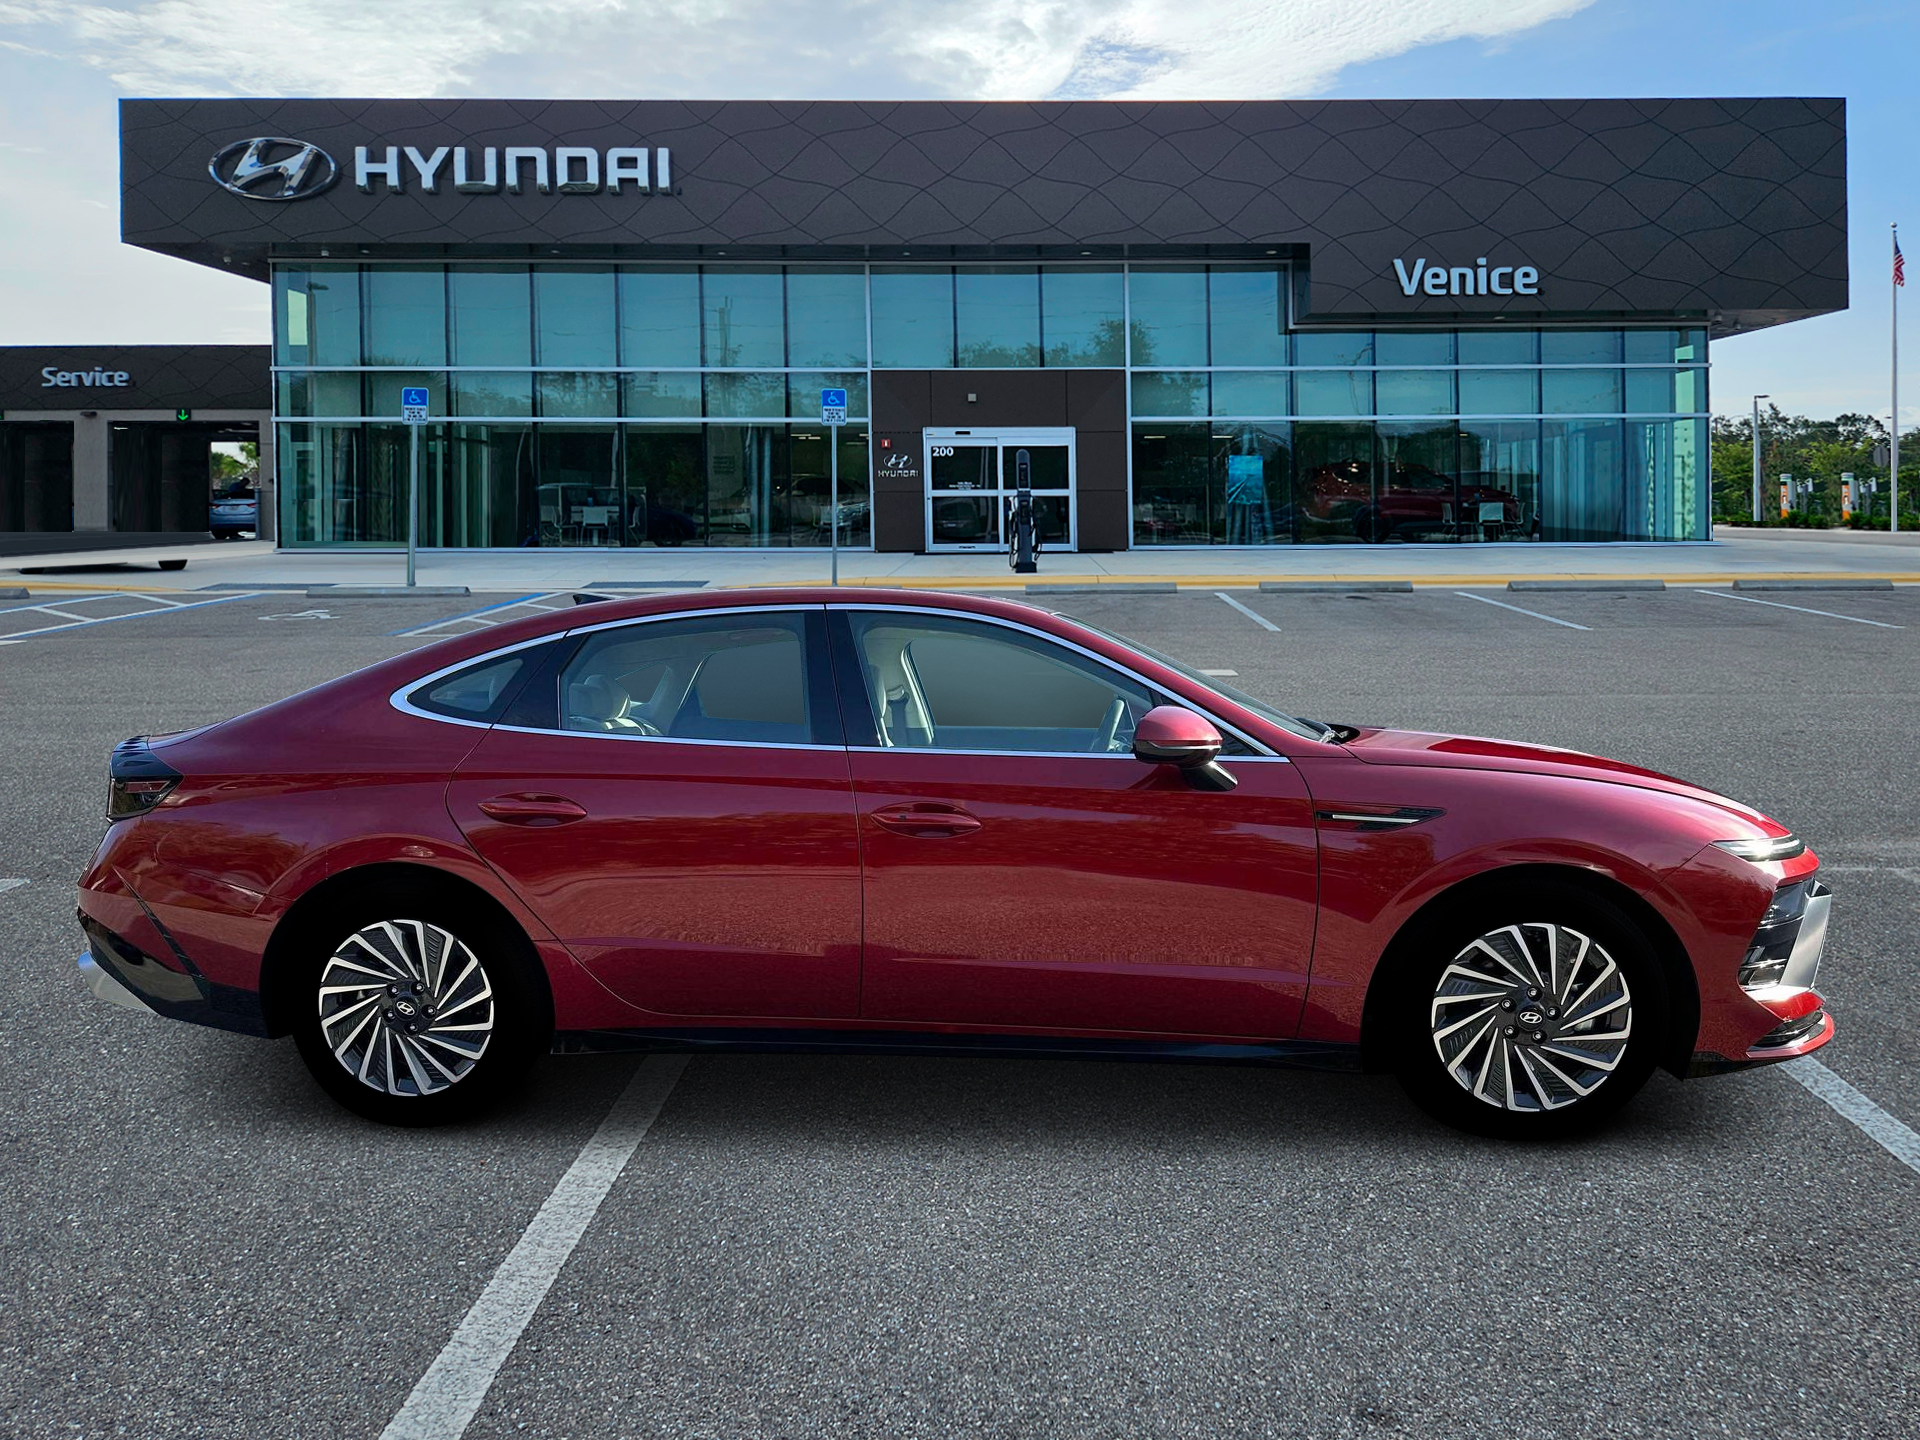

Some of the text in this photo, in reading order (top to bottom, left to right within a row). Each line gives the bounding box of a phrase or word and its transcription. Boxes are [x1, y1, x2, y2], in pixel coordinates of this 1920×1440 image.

[354, 146, 670, 193] HYUNDAI
[1393, 257, 1539, 296] Venice
[41, 366, 130, 387] Service
[932, 446, 954, 457] 200
[877, 469, 919, 478] HYUNDAI
